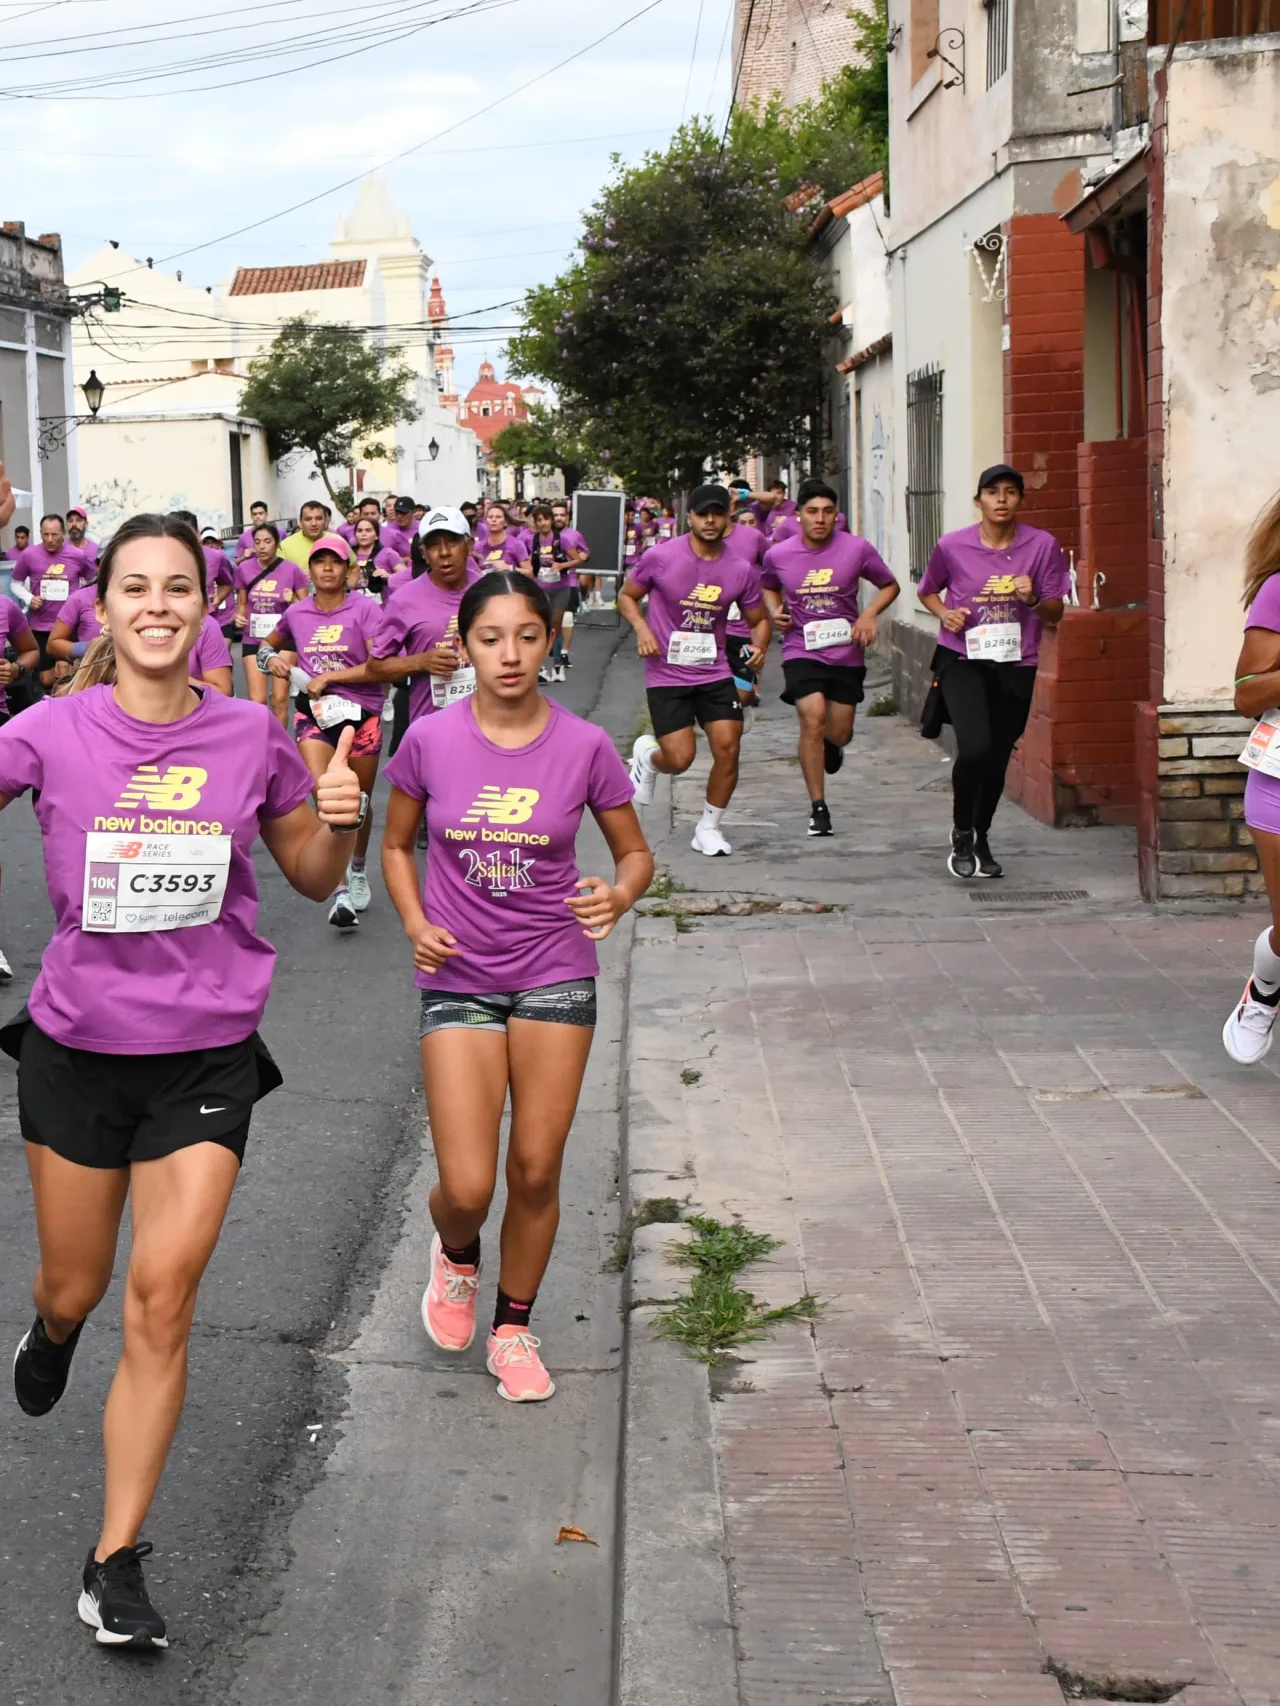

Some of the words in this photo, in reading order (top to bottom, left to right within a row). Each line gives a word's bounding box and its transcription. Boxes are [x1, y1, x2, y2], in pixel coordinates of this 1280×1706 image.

[819, 630, 849, 640] C3464
[435, 640, 453, 648] new
[683, 645, 712, 653] B2666
[984, 638, 1018, 648] B2846
[94, 815, 136, 831] new
[140, 814, 223, 835] balance
[445, 828, 477, 841] new
[481, 827, 550, 845] balance
[142, 850, 172, 858] SERIES
[459, 847, 536, 890] 21k
[478, 861, 517, 878] Salta
[91, 877, 116, 889] 10K
[129, 874, 216, 893] C3593
[164, 909, 209, 922] telecom
